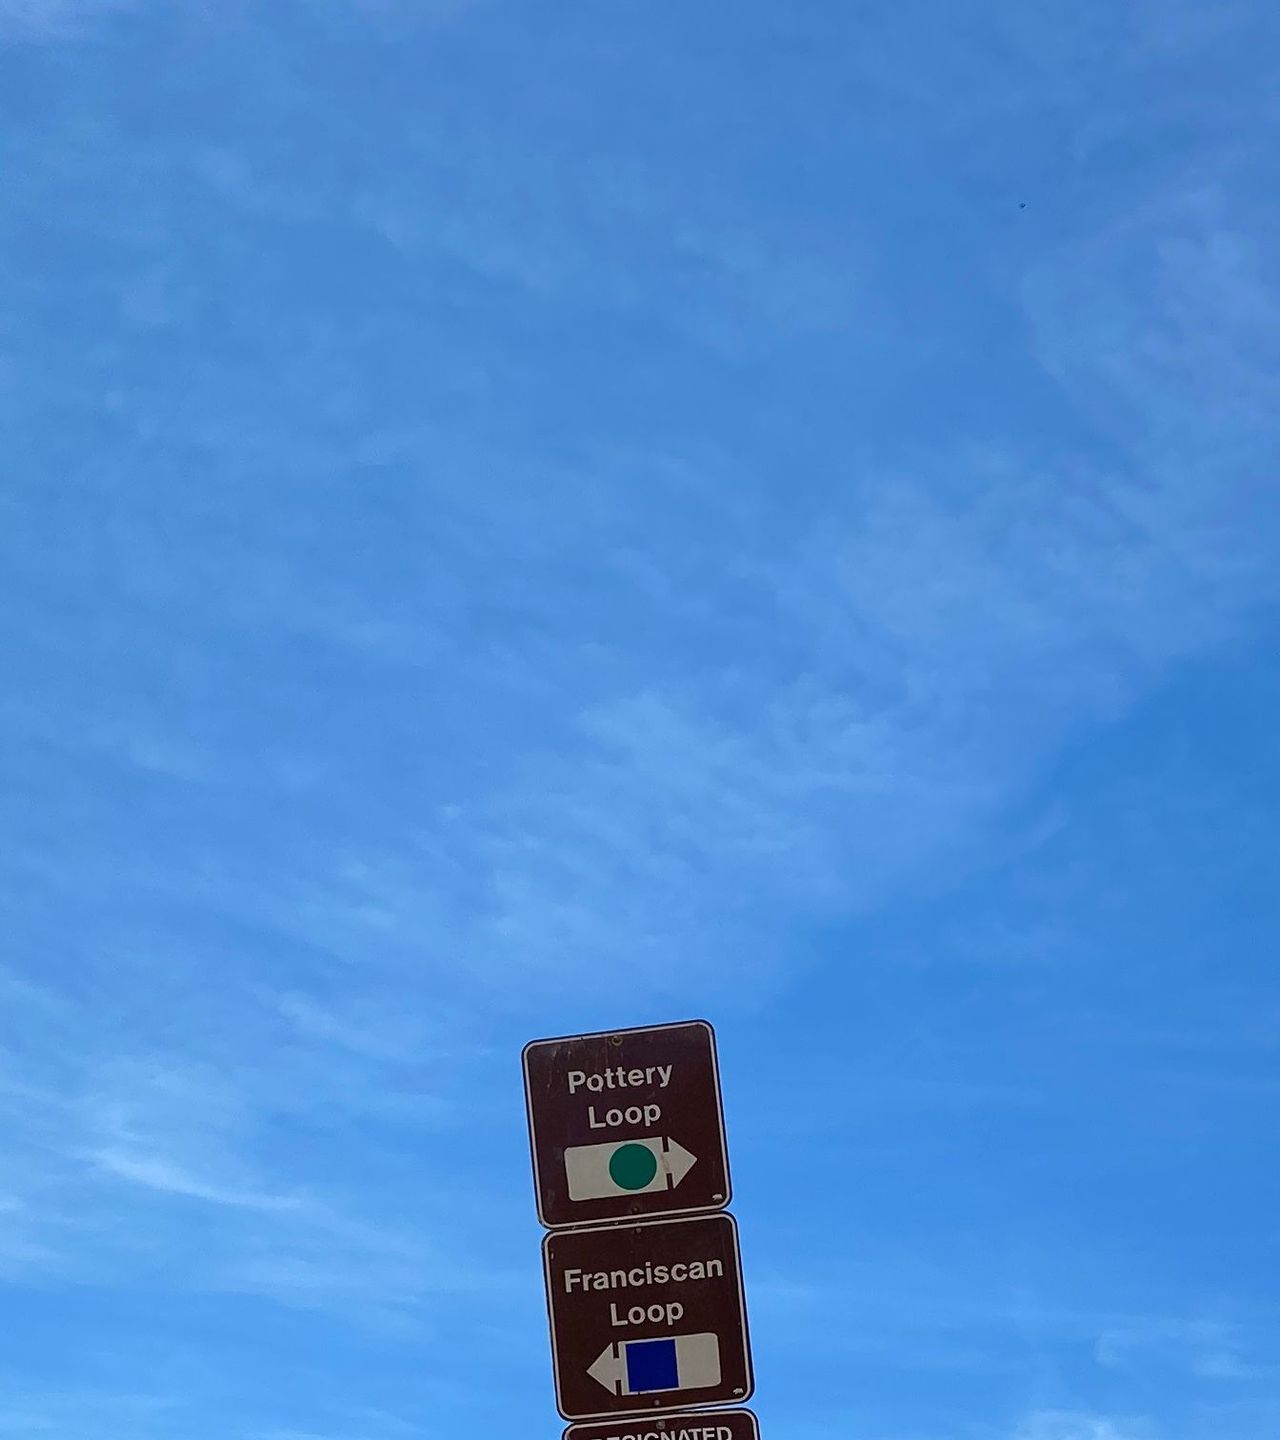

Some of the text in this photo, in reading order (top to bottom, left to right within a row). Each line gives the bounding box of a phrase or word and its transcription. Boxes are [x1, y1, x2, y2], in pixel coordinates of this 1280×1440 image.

[567, 1064, 673, 1094] Pottery
[588, 1103, 662, 1129] Loop
[564, 1259, 724, 1293] Franciscan
[610, 1301, 684, 1327] Loop
